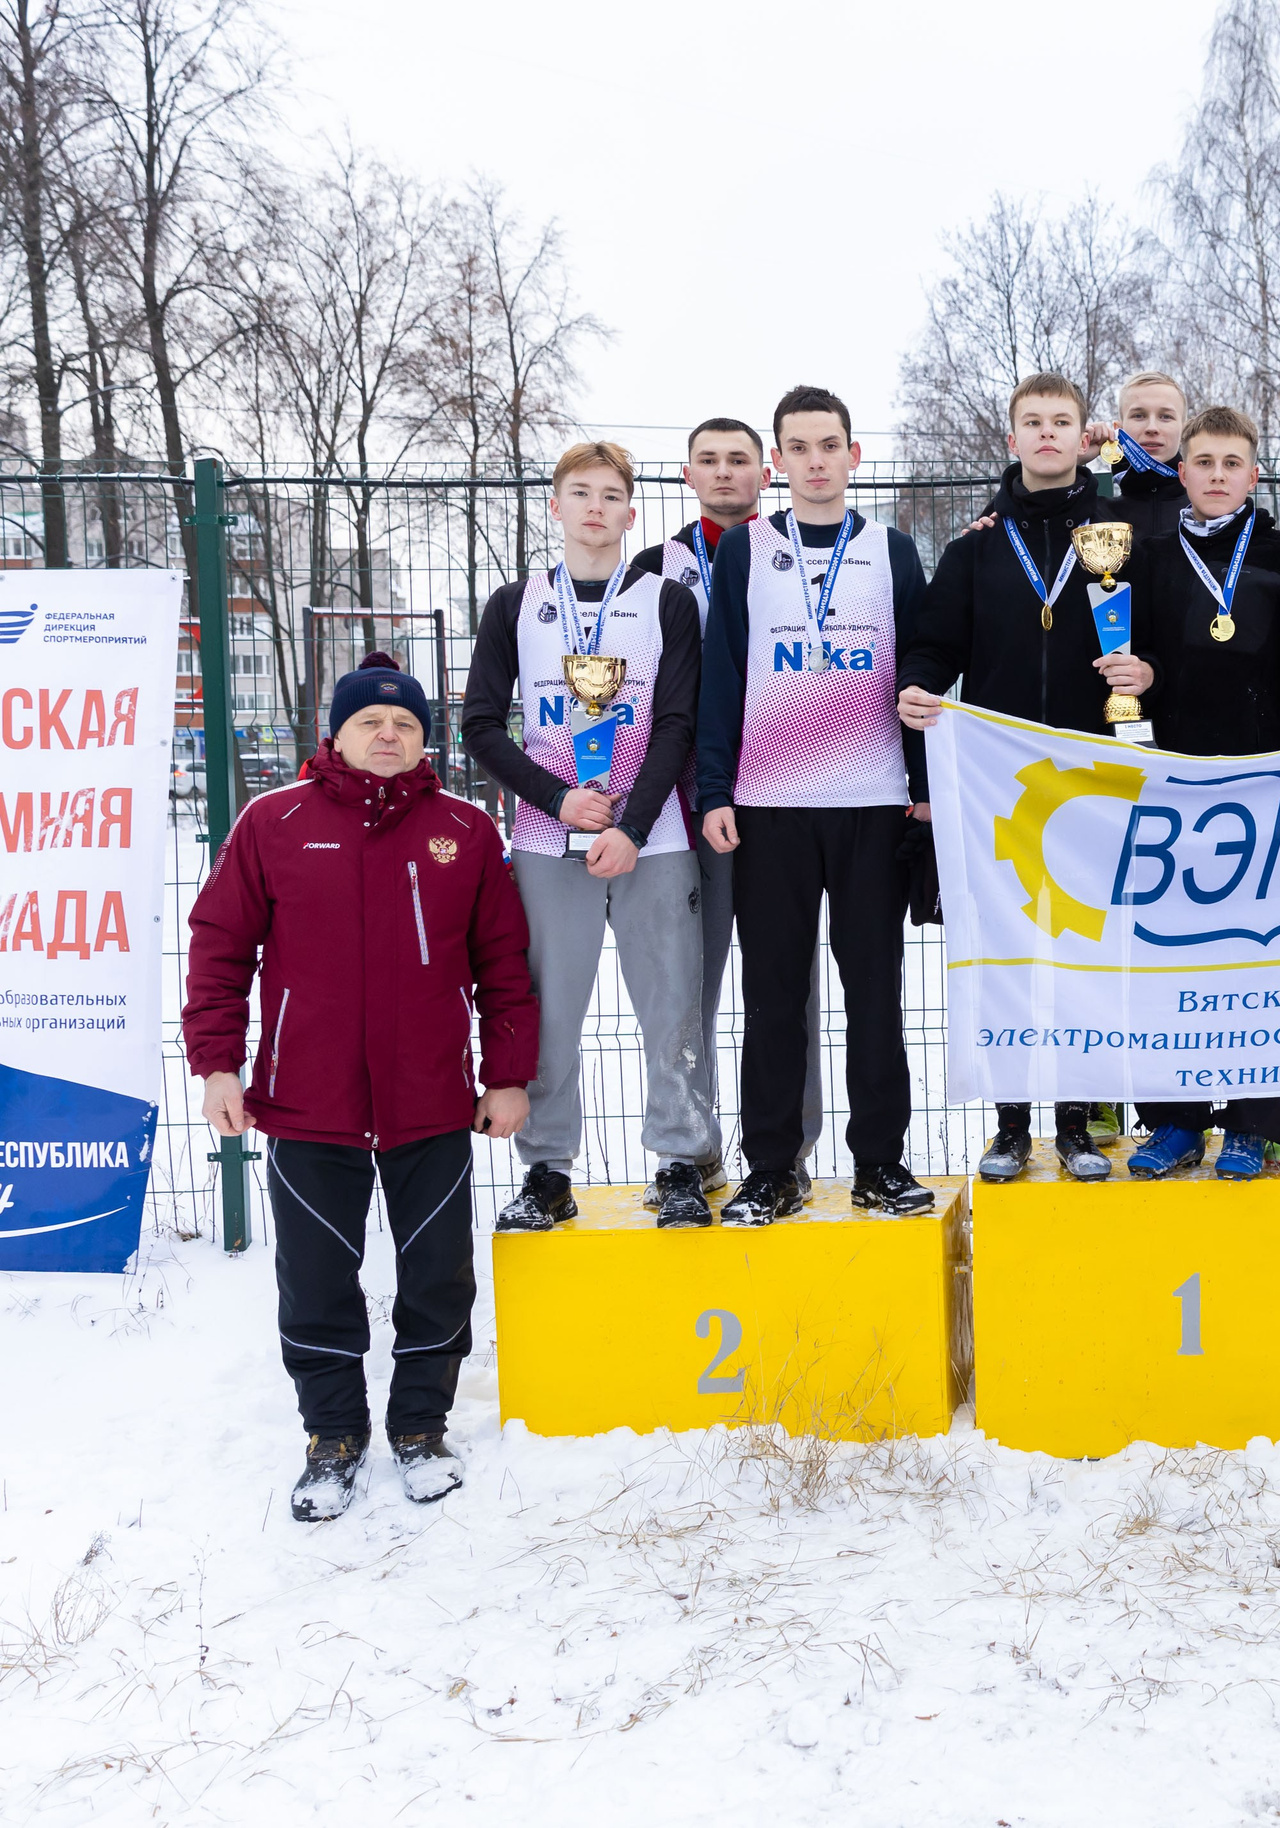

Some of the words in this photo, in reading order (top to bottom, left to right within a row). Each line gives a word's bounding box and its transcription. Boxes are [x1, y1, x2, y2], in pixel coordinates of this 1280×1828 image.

[796, 557, 806, 577] СПОРТА
[800, 578, 814, 619] МИНИСТЕРСТВО
[43, 635, 147, 644] СПОРТМЕРОПРИЯТИЙ
[44, 624, 96, 632] ДИРЕКЦИЯ
[2, 687, 139, 750] СКАЯ
[539, 696, 635, 726] Na
[303, 842, 341, 850] FORWARD
[25, 1015, 126, 1032] организаций
[1173, 1272, 1204, 1356] 1
[694, 1309, 746, 1395] 2
